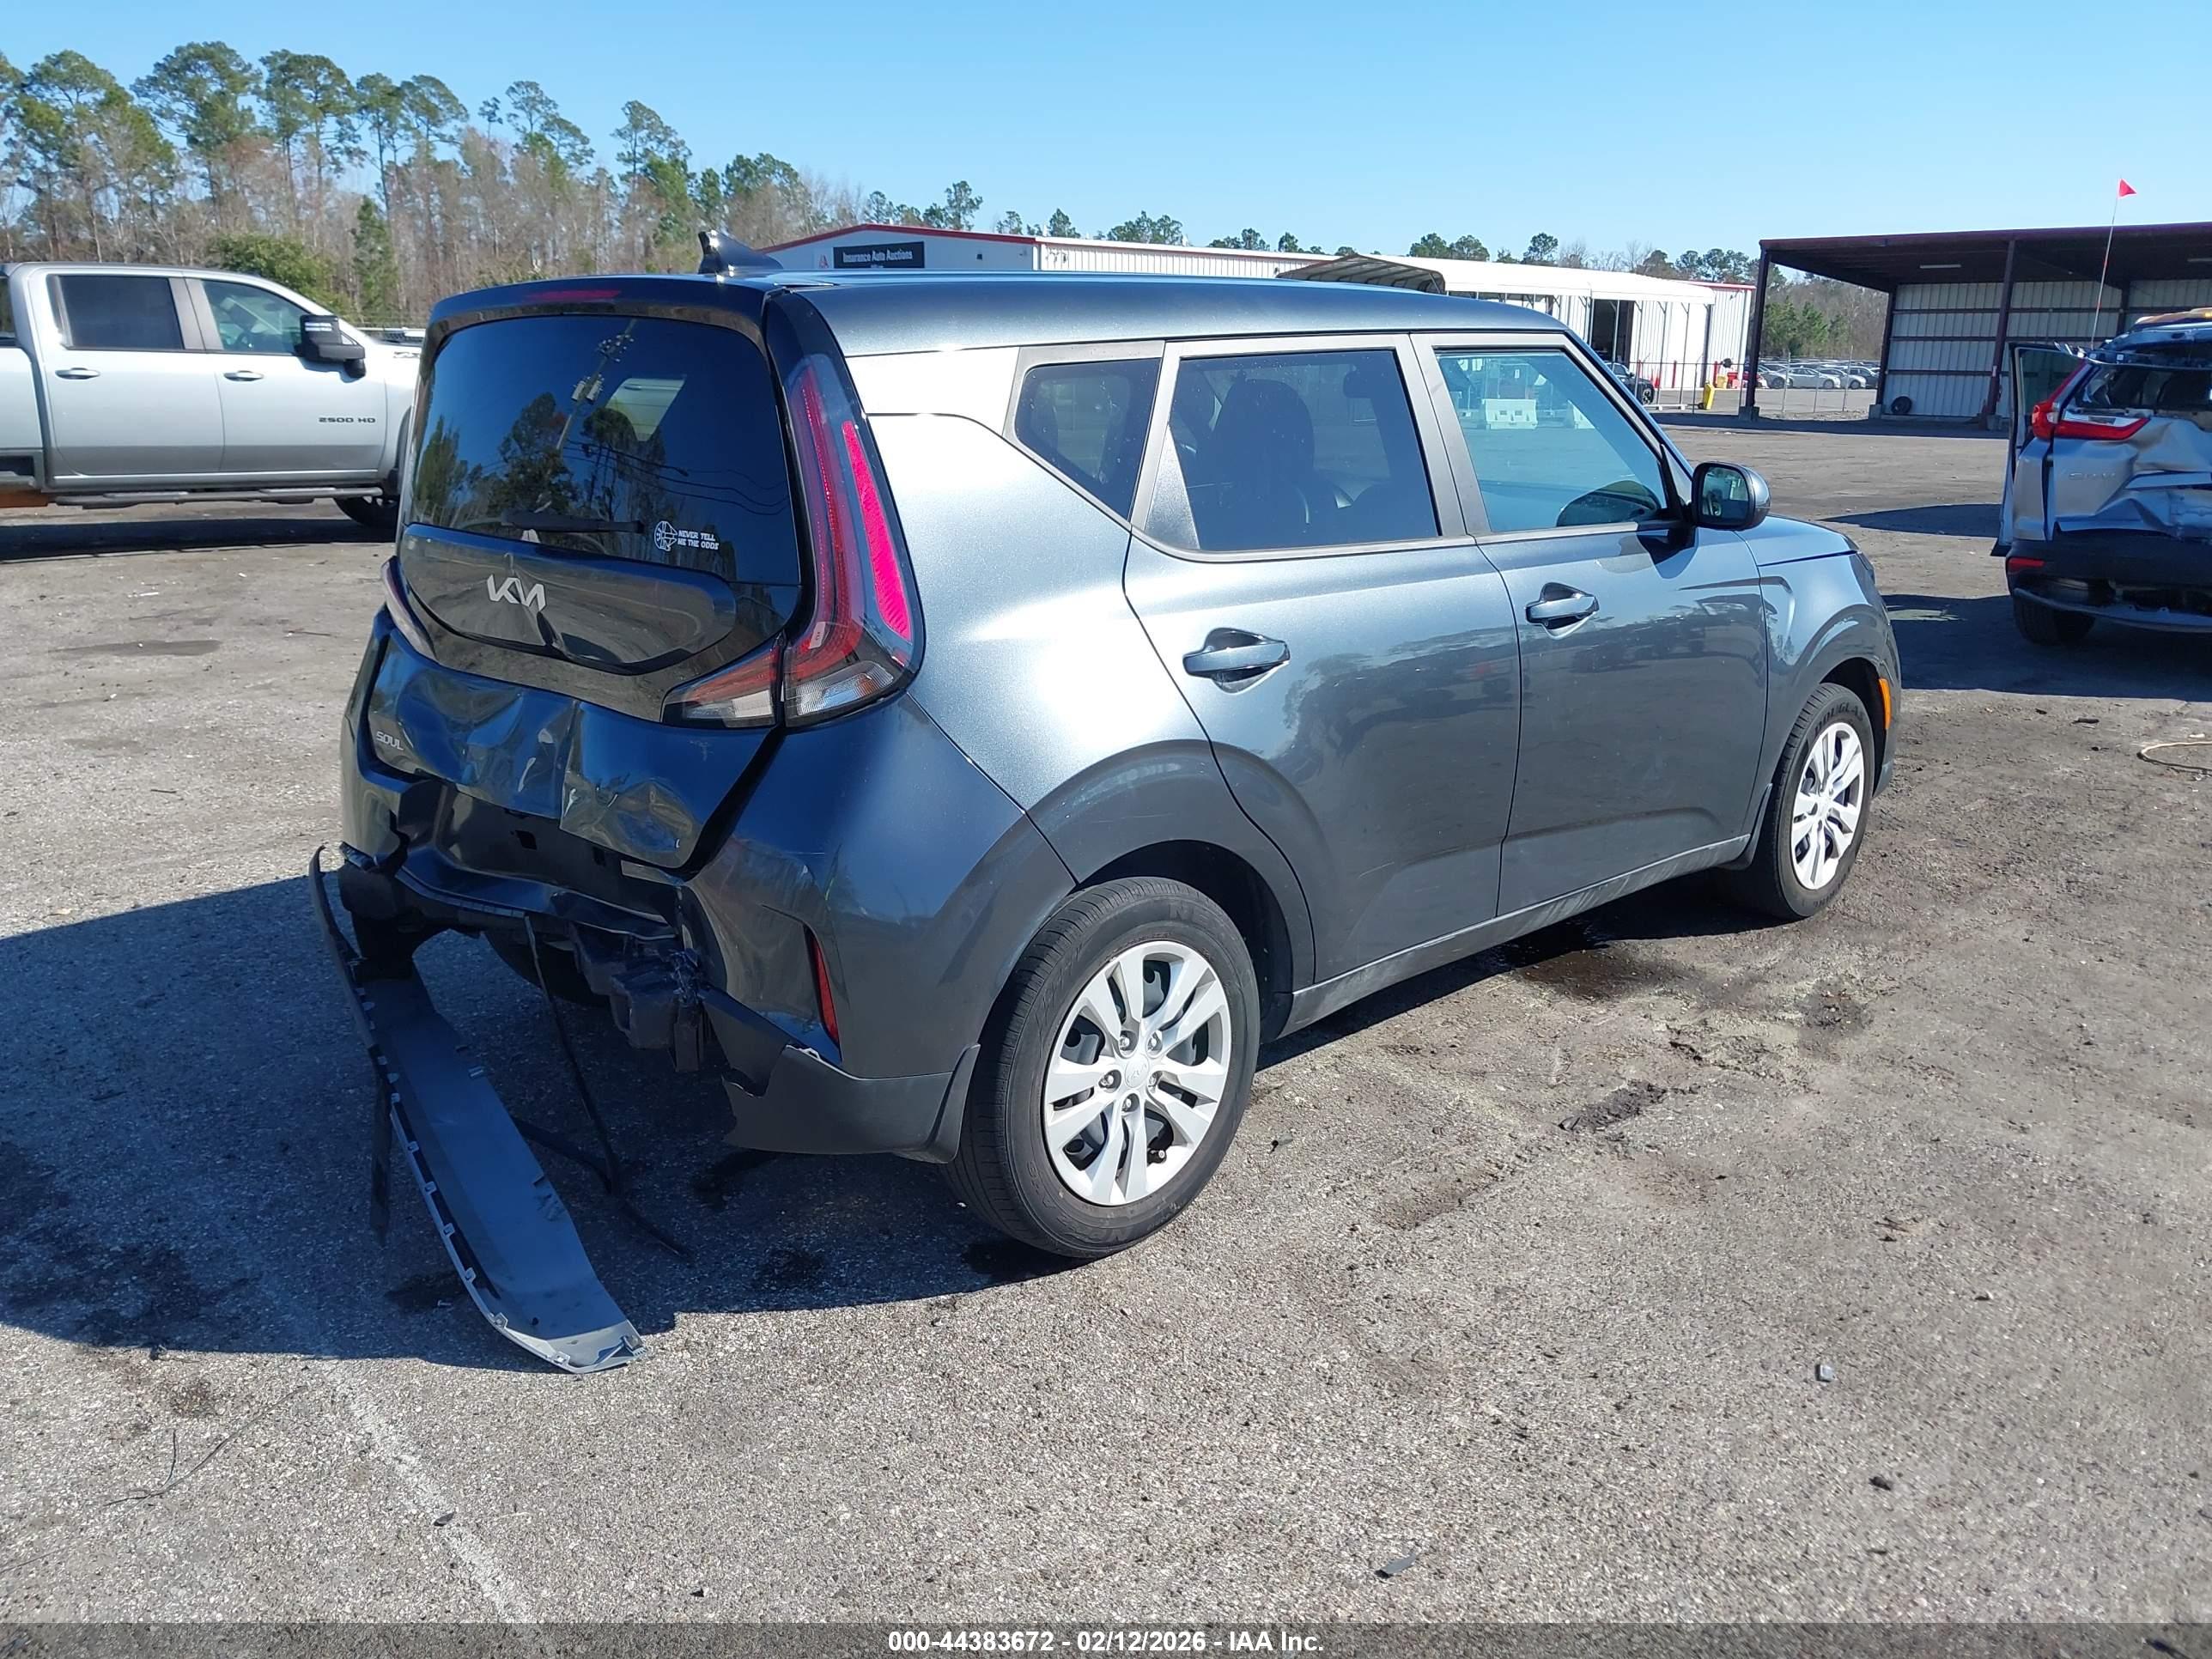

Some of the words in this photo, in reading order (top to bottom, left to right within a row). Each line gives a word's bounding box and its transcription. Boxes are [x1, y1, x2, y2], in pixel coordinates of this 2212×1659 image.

[842, 252, 871, 263] Insurance
[872, 250, 885, 261] Auto
[886, 249, 913, 261] Auctions
[678, 530, 698, 539] NEVER
[700, 532, 715, 542] TELL
[701, 541, 719, 550] ODDS
[376, 731, 404, 750] SOUL
